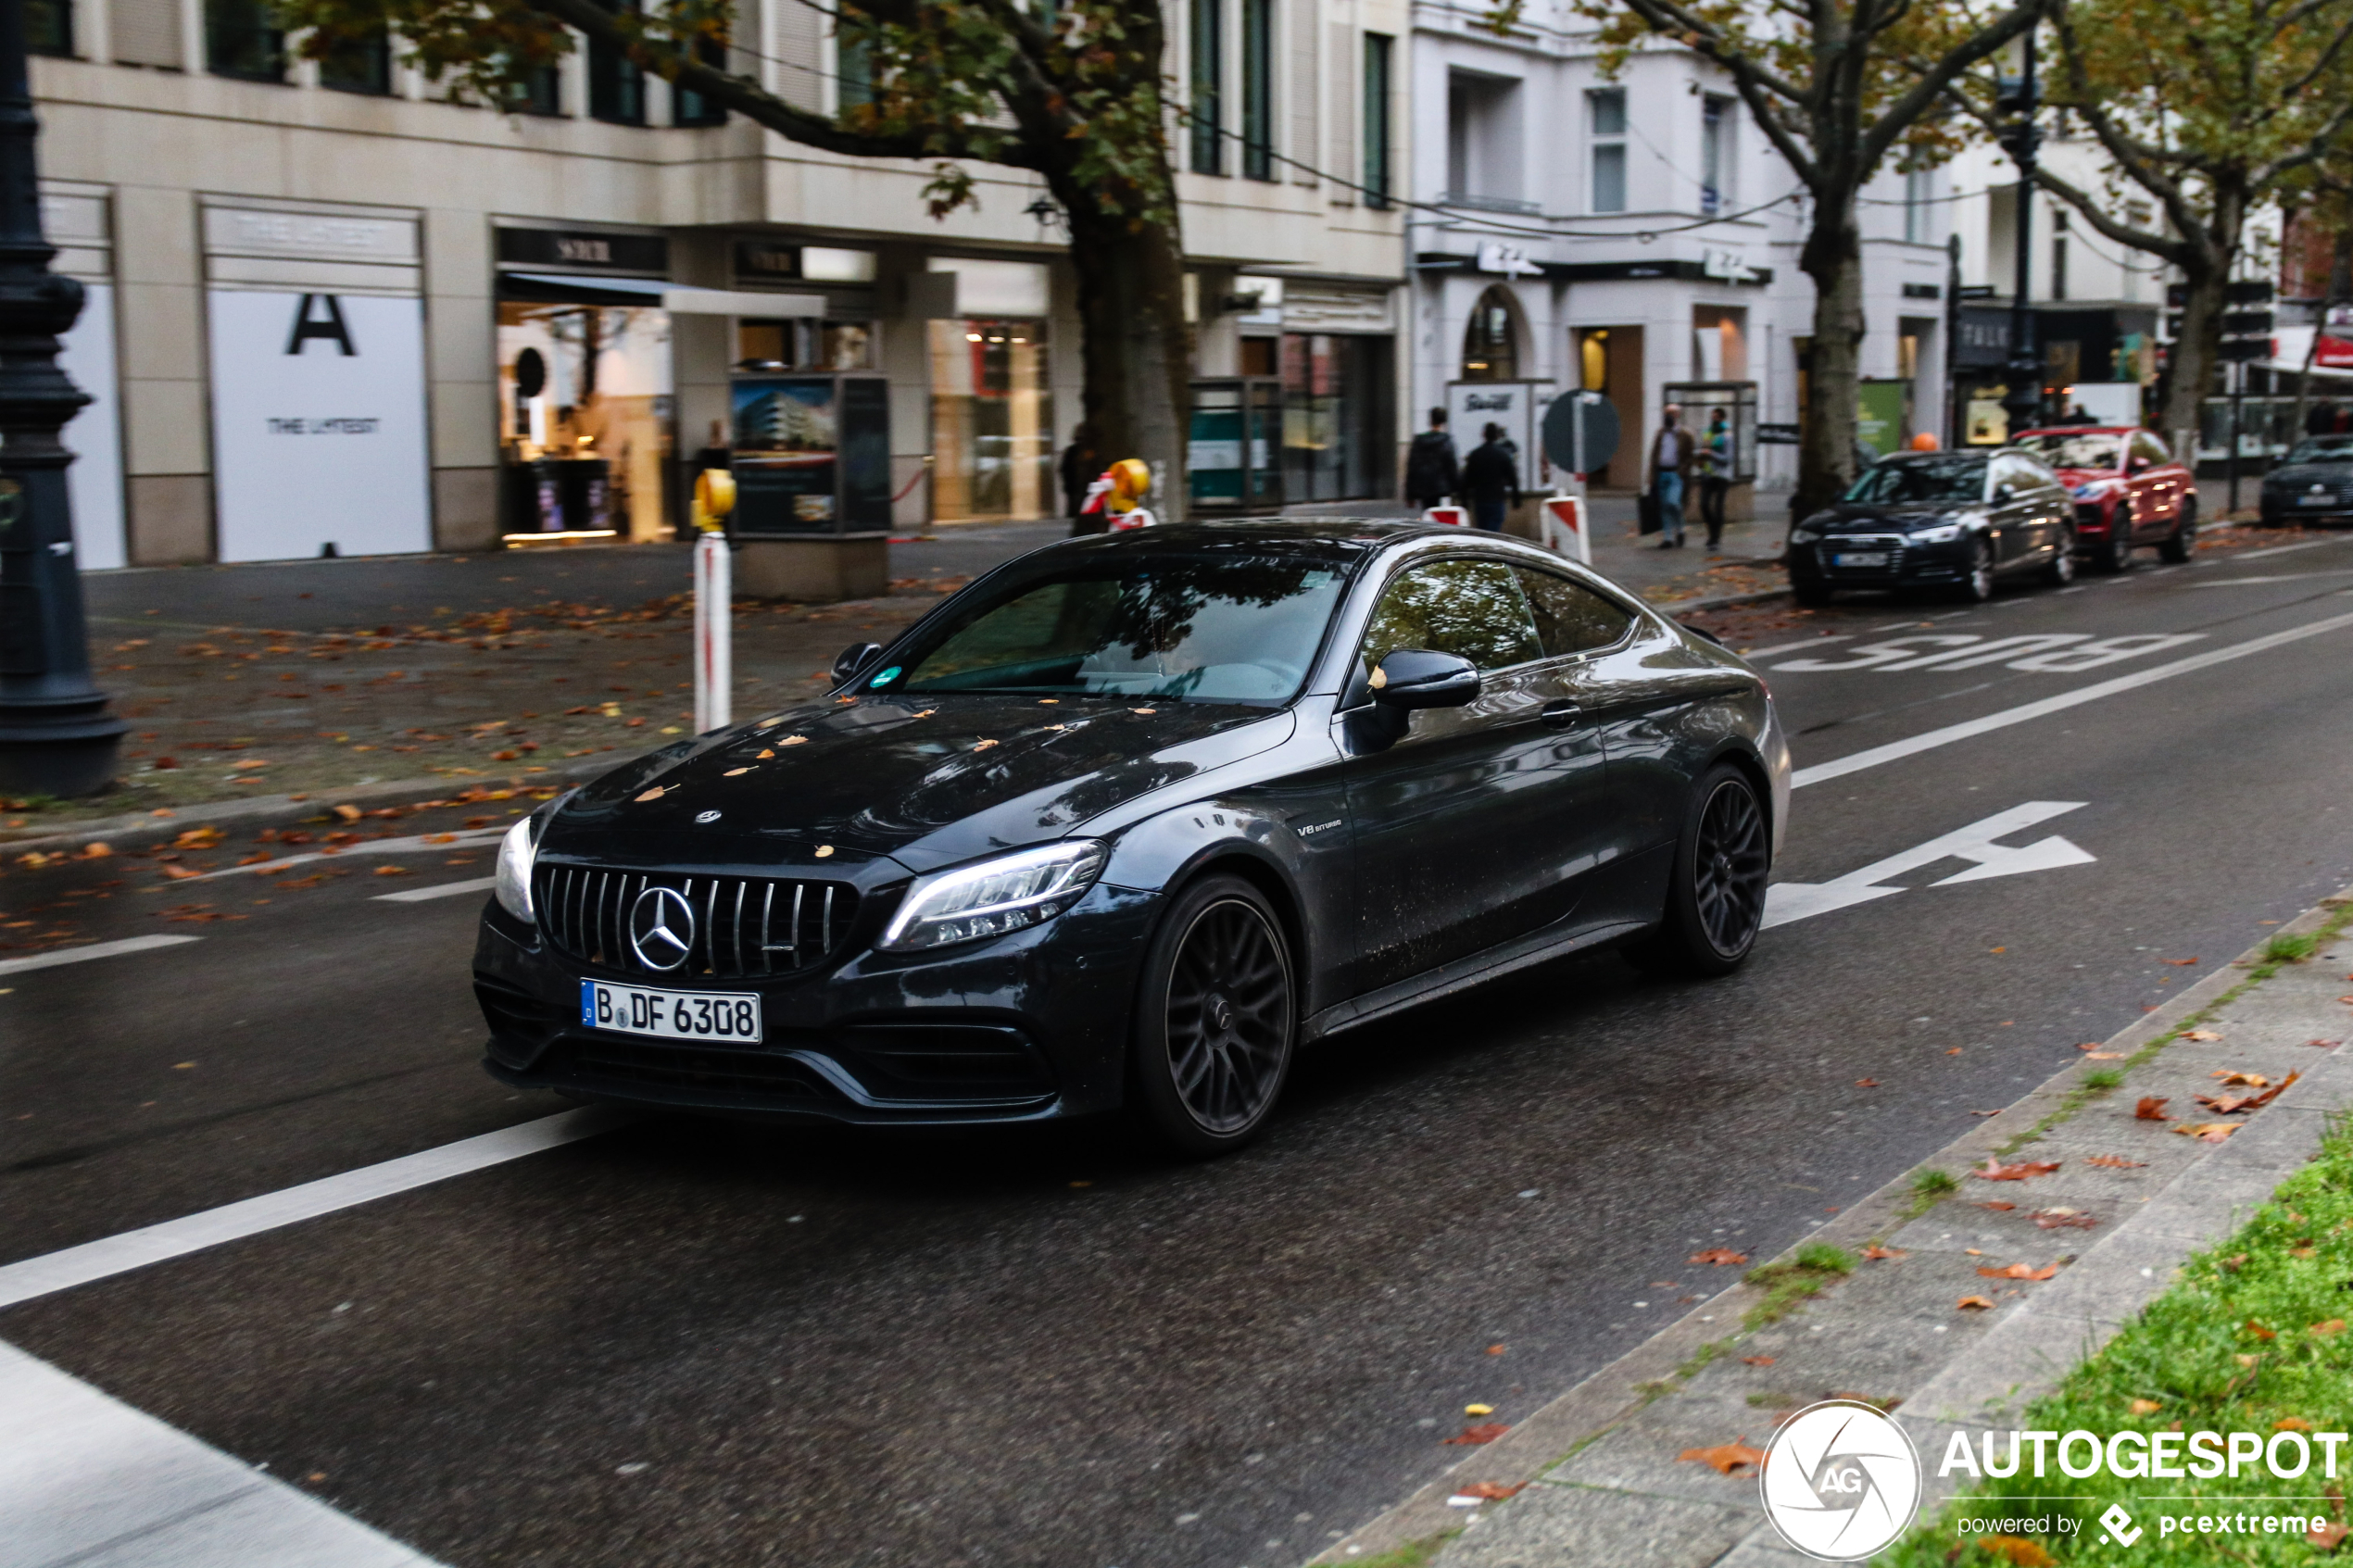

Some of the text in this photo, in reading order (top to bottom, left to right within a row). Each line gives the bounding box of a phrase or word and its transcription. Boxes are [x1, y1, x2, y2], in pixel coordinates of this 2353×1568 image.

[268, 418, 380, 434] THE LATEST
[1297, 819, 1341, 837] V8 BITURBO
[598, 987, 755, 1037] B DF 6308
